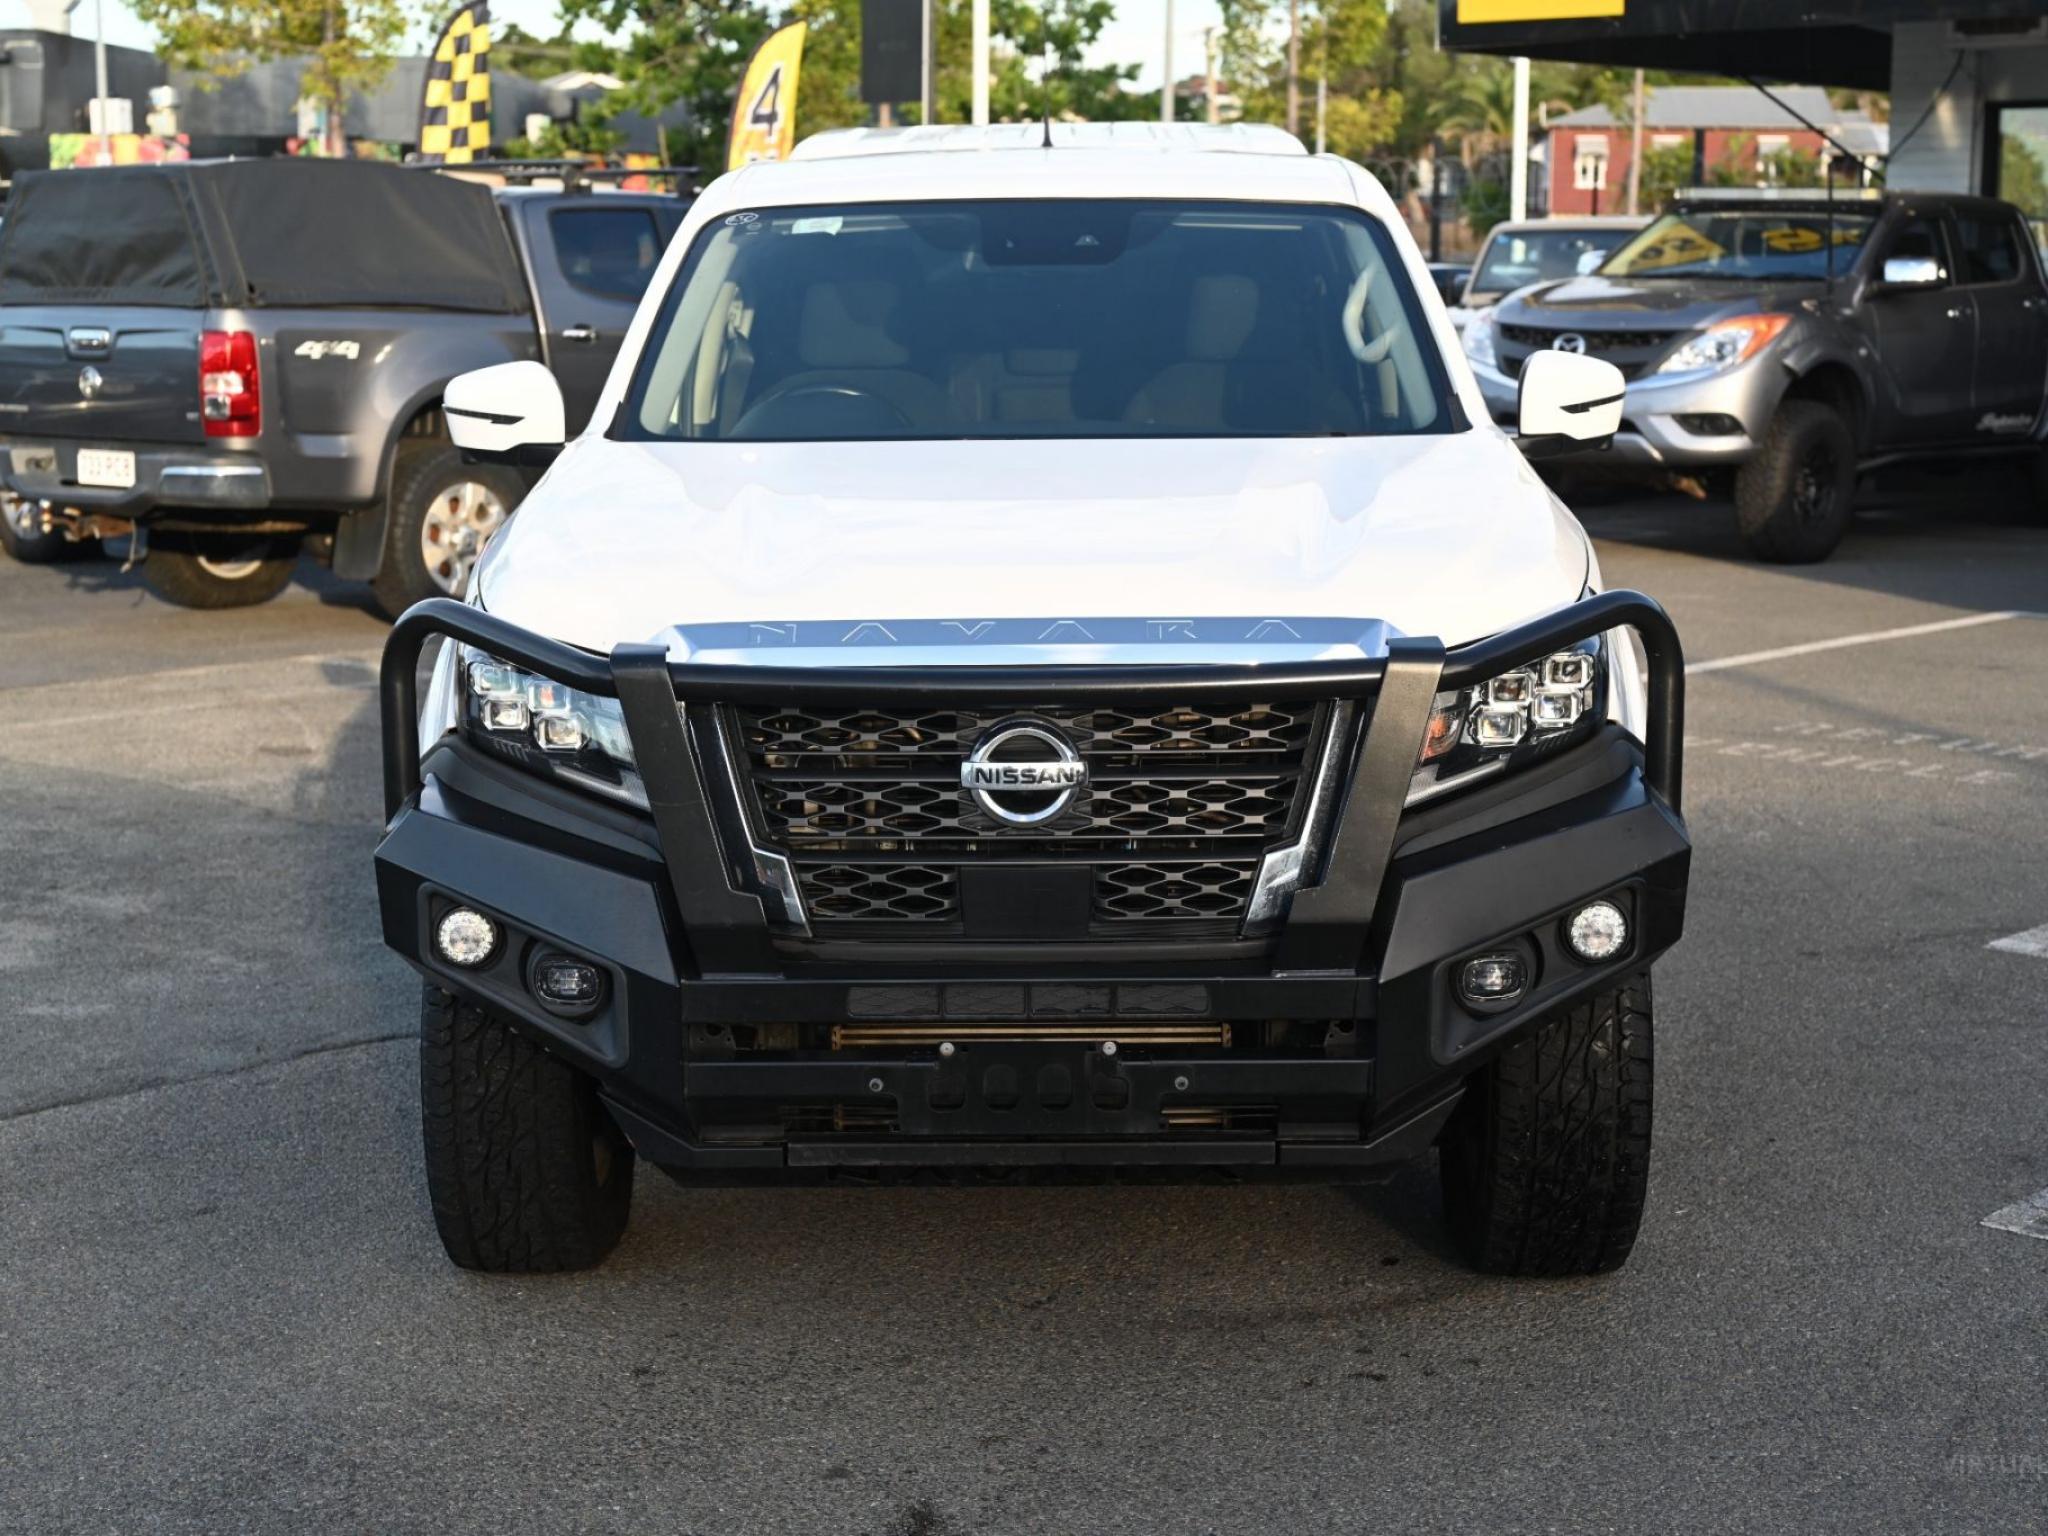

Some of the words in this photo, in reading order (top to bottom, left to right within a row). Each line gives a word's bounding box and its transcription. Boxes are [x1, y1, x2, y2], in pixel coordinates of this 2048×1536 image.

[751, 66, 781, 137] 4
[749, 619, 1302, 645] NAVARA
[974, 766, 1076, 785] NISSAN
